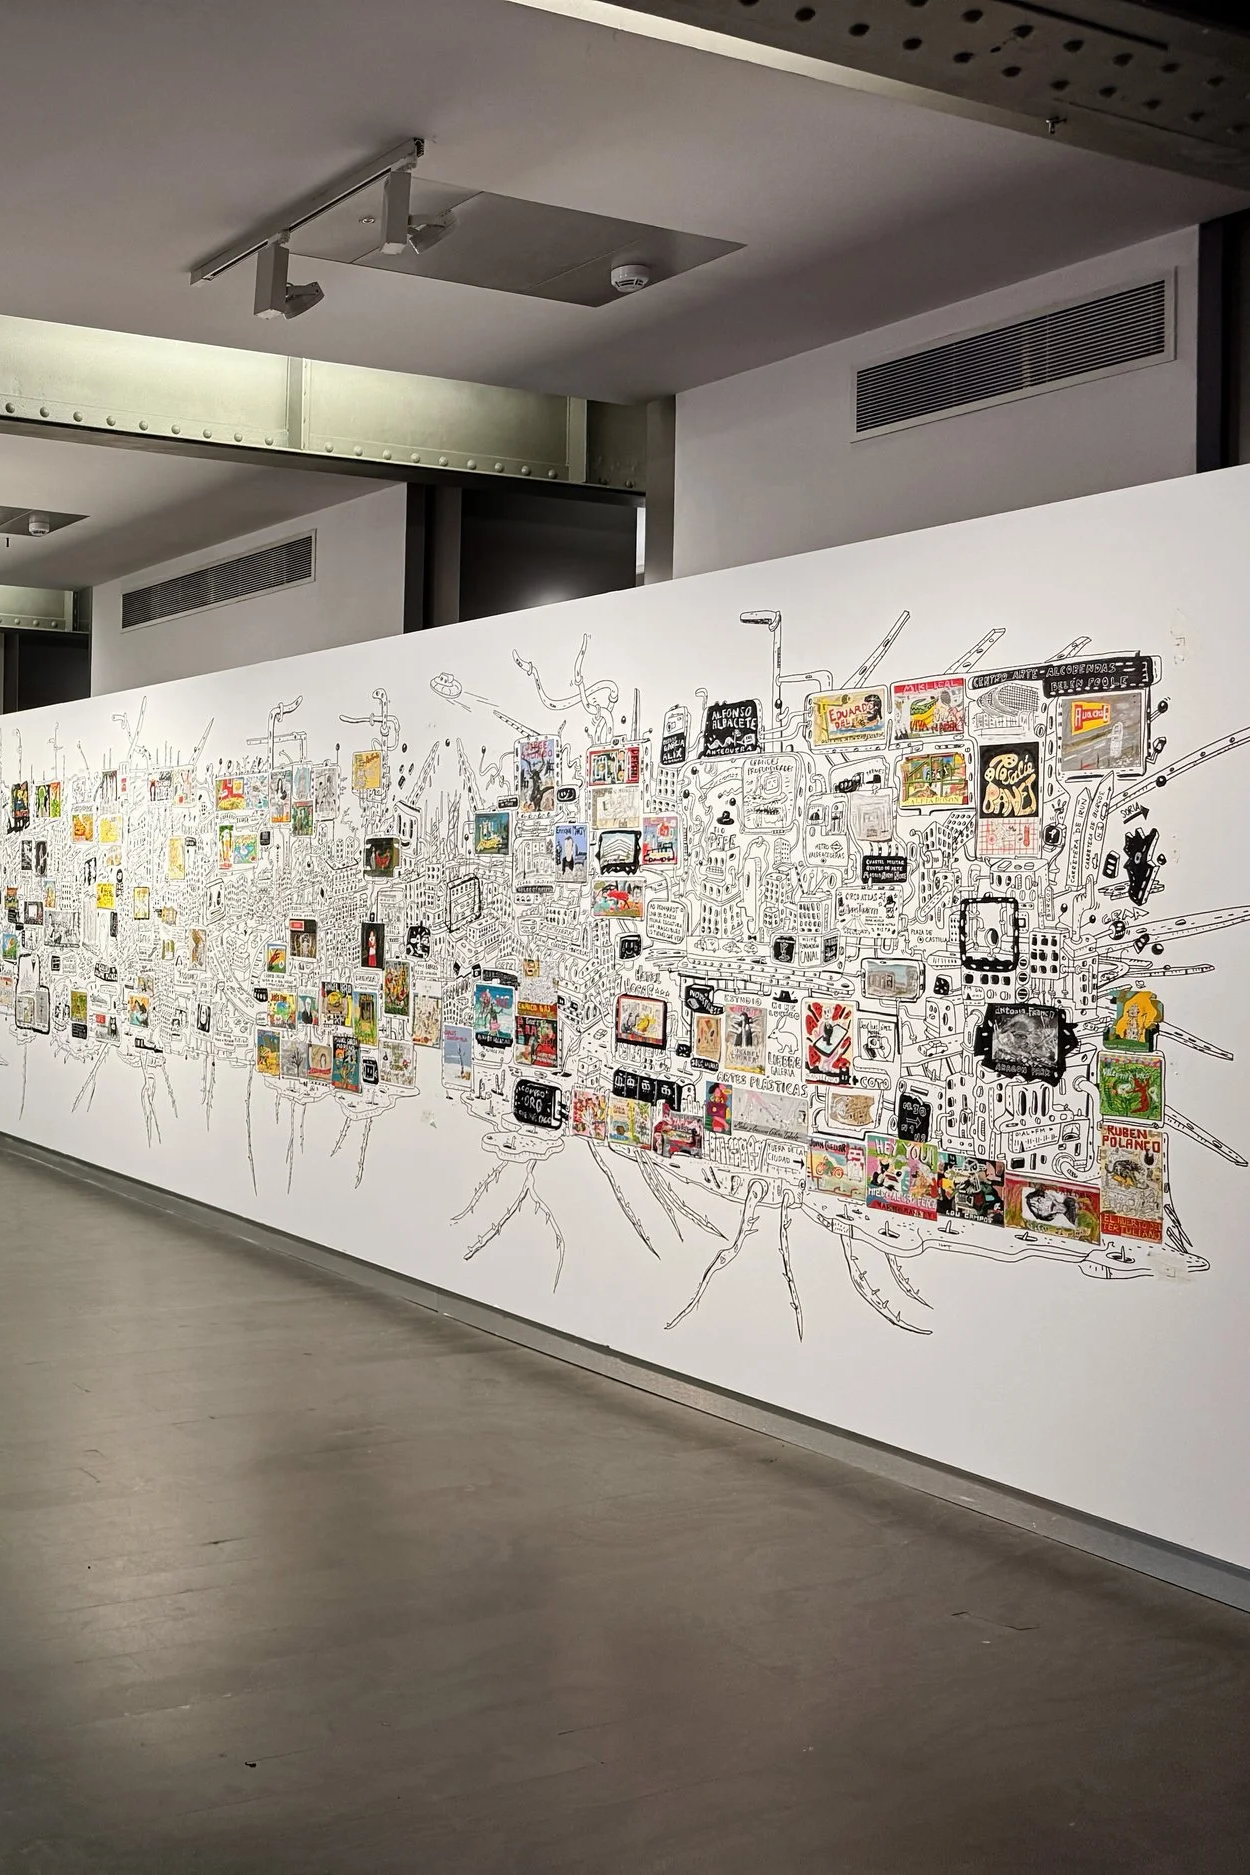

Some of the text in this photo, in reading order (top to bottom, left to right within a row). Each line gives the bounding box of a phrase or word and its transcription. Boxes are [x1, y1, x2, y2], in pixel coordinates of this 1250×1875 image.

[712, 706, 752, 720] ALFONSO
[712, 718, 757, 730] ALBACETE
[717, 1071, 747, 1085] ARTES
[750, 1075, 810, 1099] PLÁSTICAS
[860, 1076, 890, 1090] COTO
[1107, 1125, 1147, 1139] RUBEN
[876, 1139, 897, 1155] HEY
[1102, 1135, 1161, 1153] POLANCO
[768, 1153, 791, 1164] CIUDAD
[1103, 1213, 1115, 1223] EL
